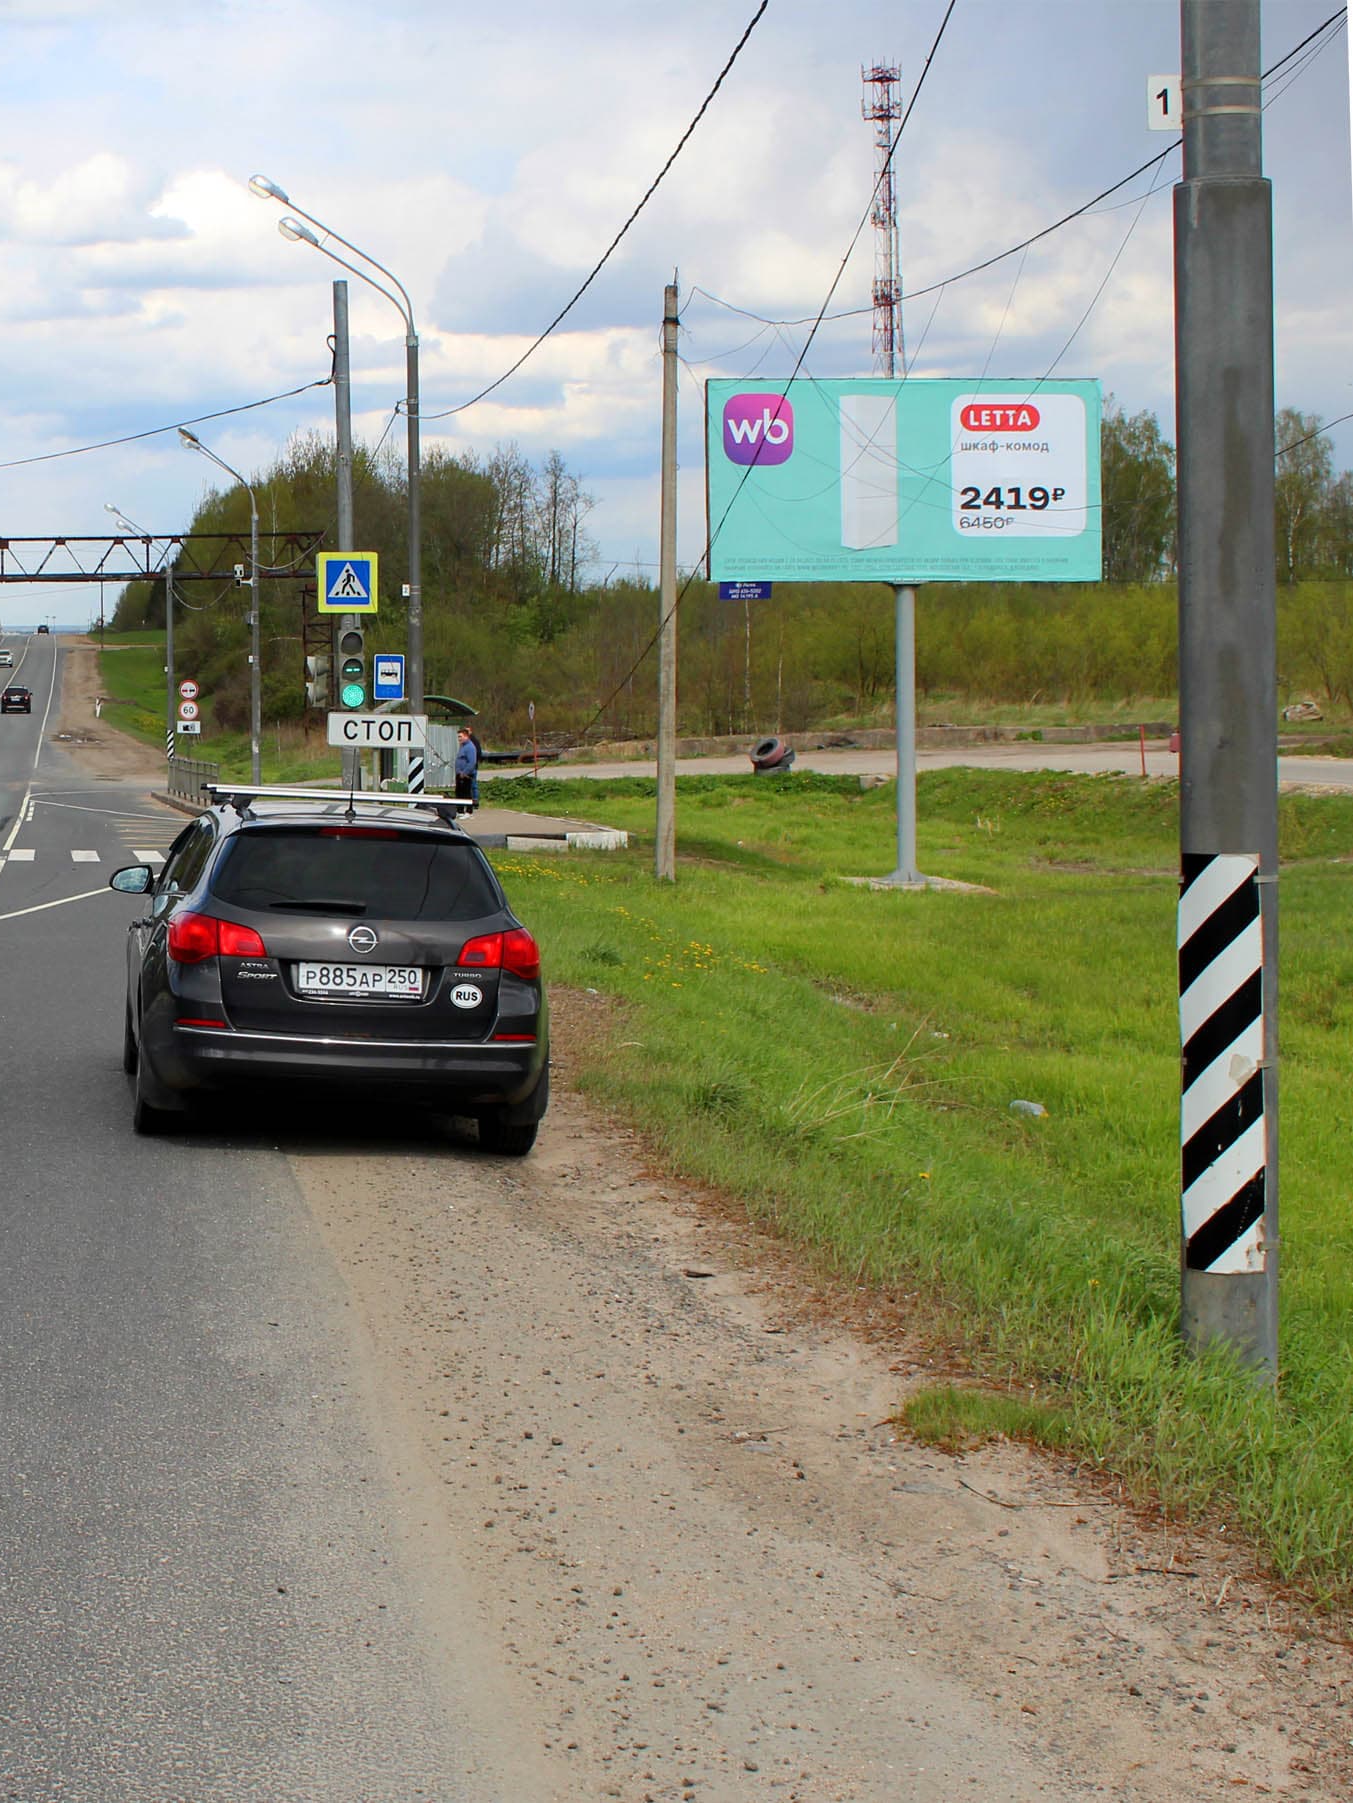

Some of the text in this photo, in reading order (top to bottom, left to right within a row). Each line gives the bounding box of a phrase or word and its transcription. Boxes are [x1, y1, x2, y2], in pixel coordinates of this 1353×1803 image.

[1156, 88, 1169, 115] 1
[727, 407, 790, 445] wb
[969, 410, 1032, 426] LETTA
[960, 439, 1050, 454] шкаф-комод
[183, 705, 195, 714] 60
[343, 720, 412, 741] СТОП
[455, 991, 479, 1001] RUS
